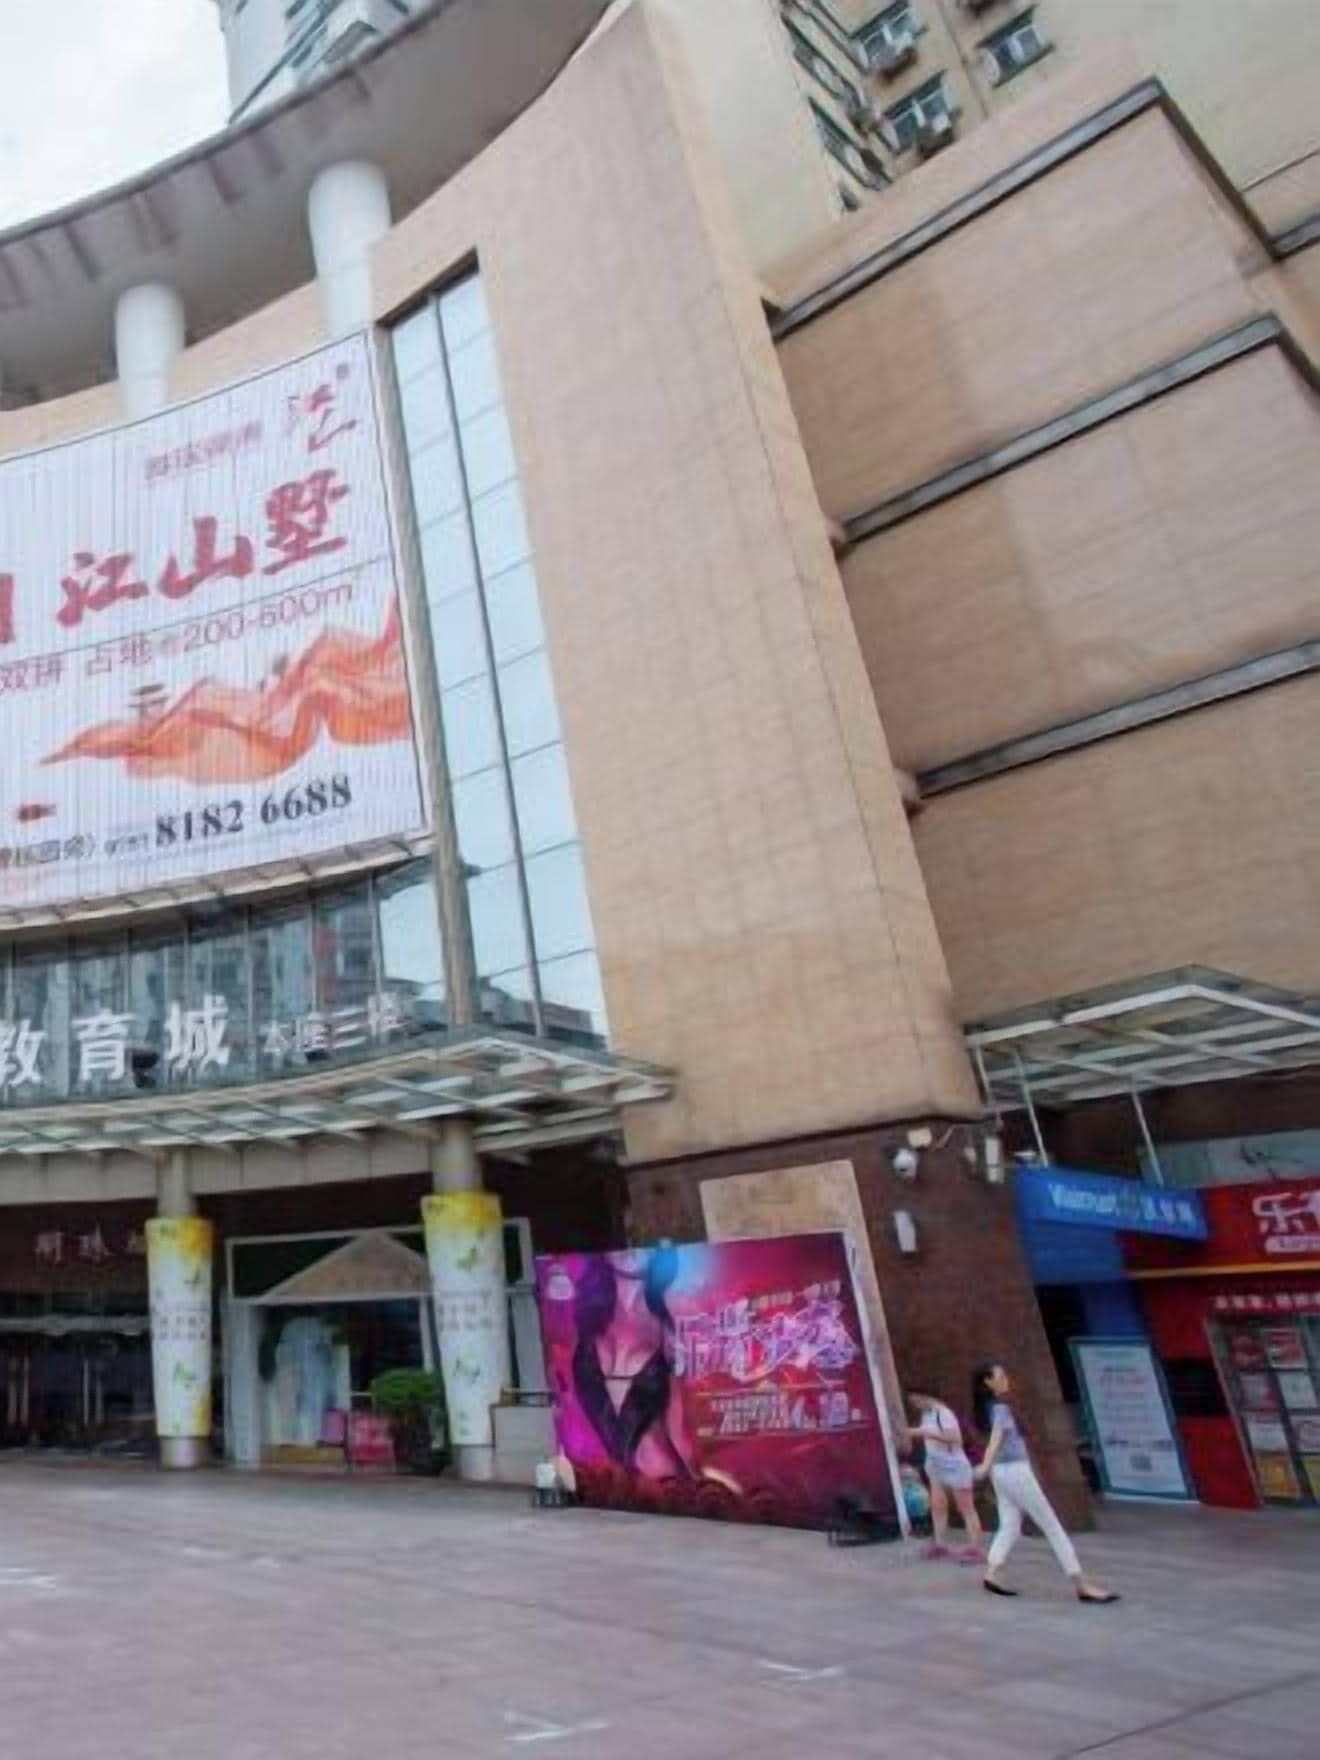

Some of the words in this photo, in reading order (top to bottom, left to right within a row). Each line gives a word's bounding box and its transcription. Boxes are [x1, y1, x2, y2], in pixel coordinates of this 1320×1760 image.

[57, 467, 351, 629] 江山墅
[155, 799, 245, 849] 8182
[260, 772, 353, 825] 6688
